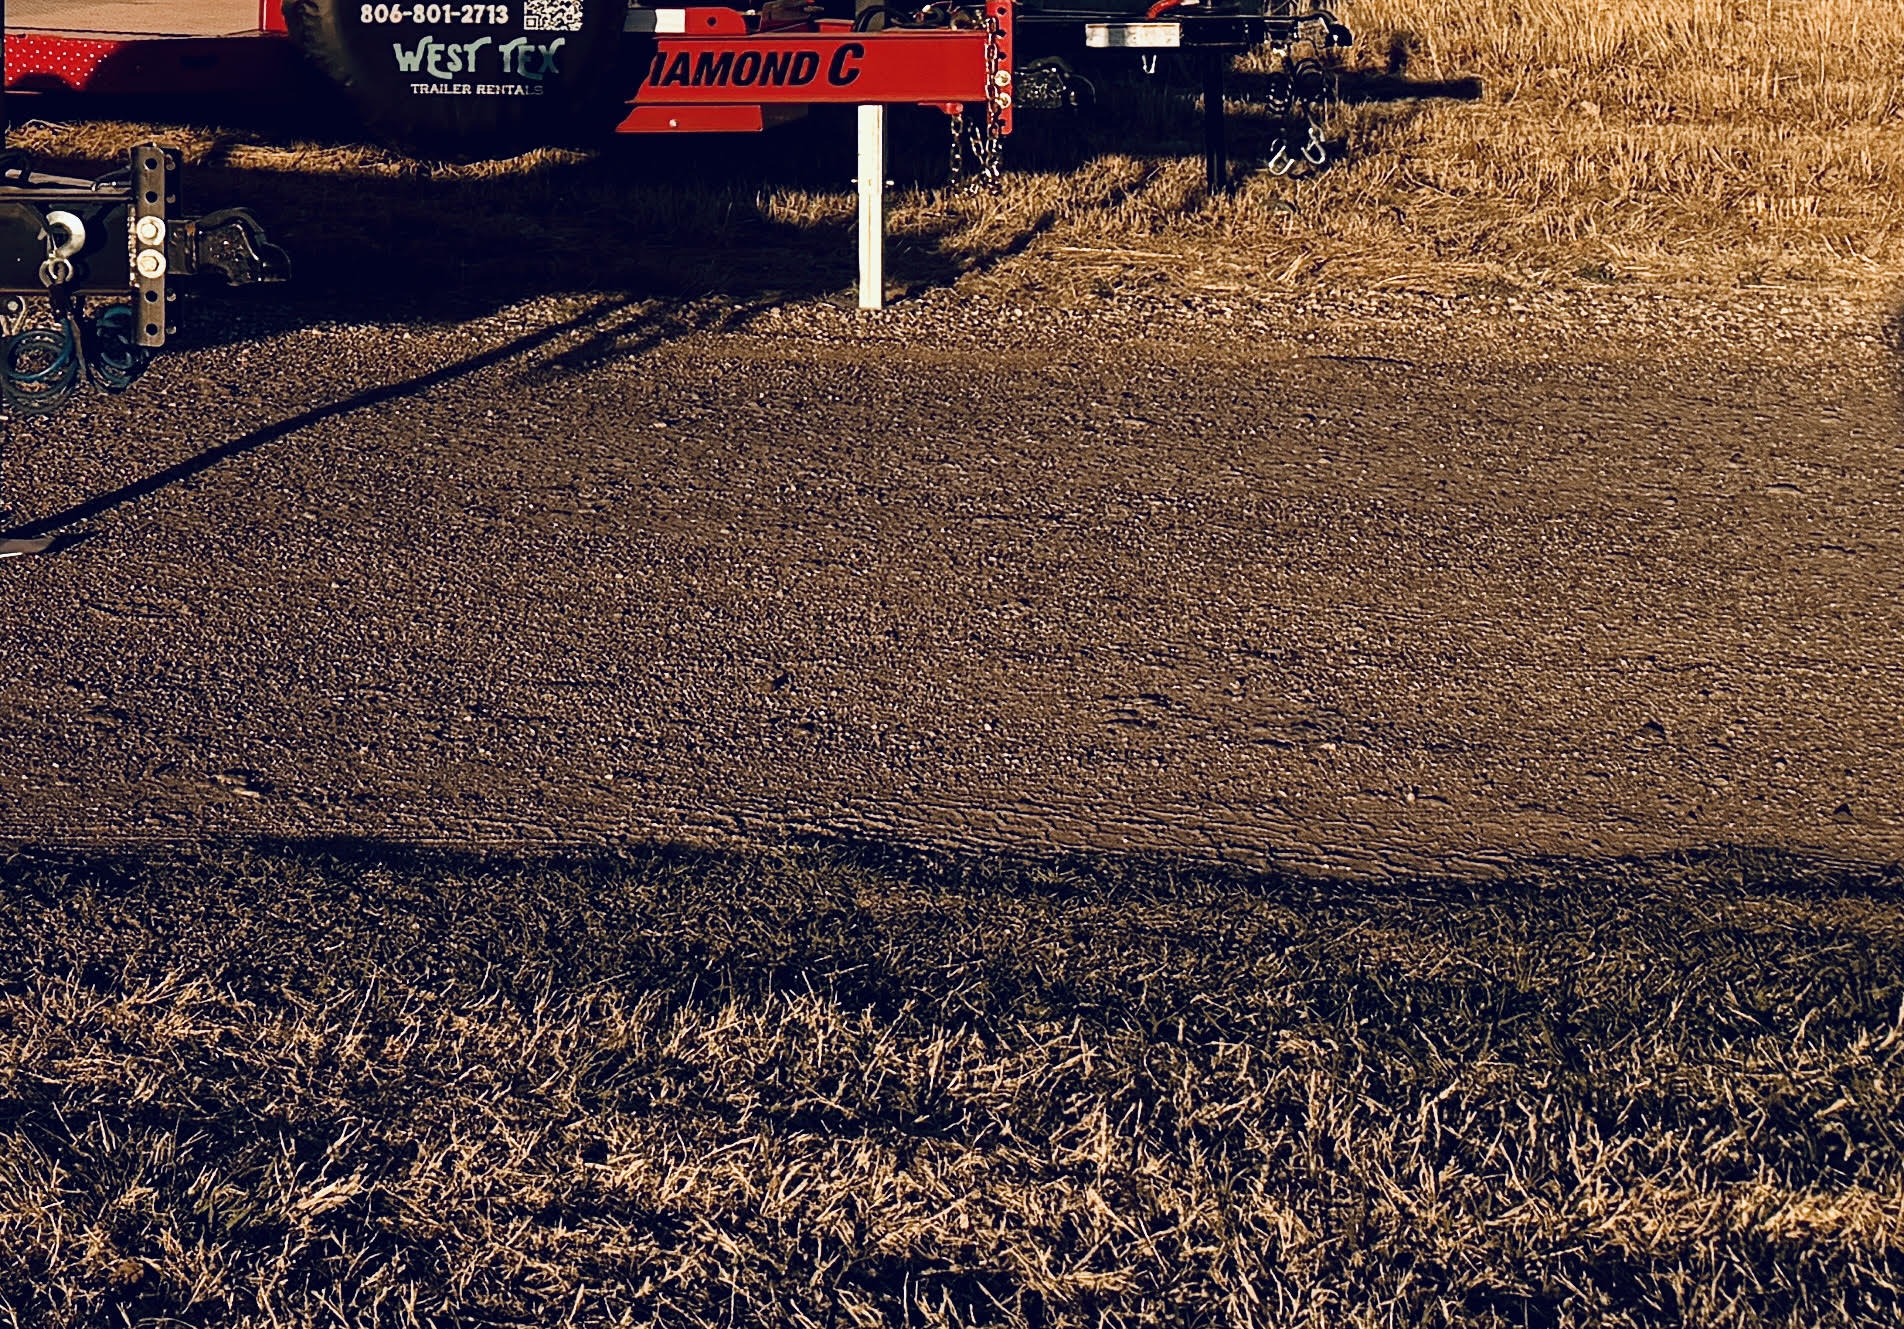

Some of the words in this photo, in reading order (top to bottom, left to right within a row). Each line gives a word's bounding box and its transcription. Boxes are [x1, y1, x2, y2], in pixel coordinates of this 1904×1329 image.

[360, 3, 509, 25] 806-801-2713
[392, 35, 492, 80] WEST
[498, 36, 566, 81] TEX
[648, 50, 820, 87] IAMOND
[827, 42, 865, 87] C
[410, 83, 472, 95] TRAILER
[476, 84, 544, 96] RENTALS
